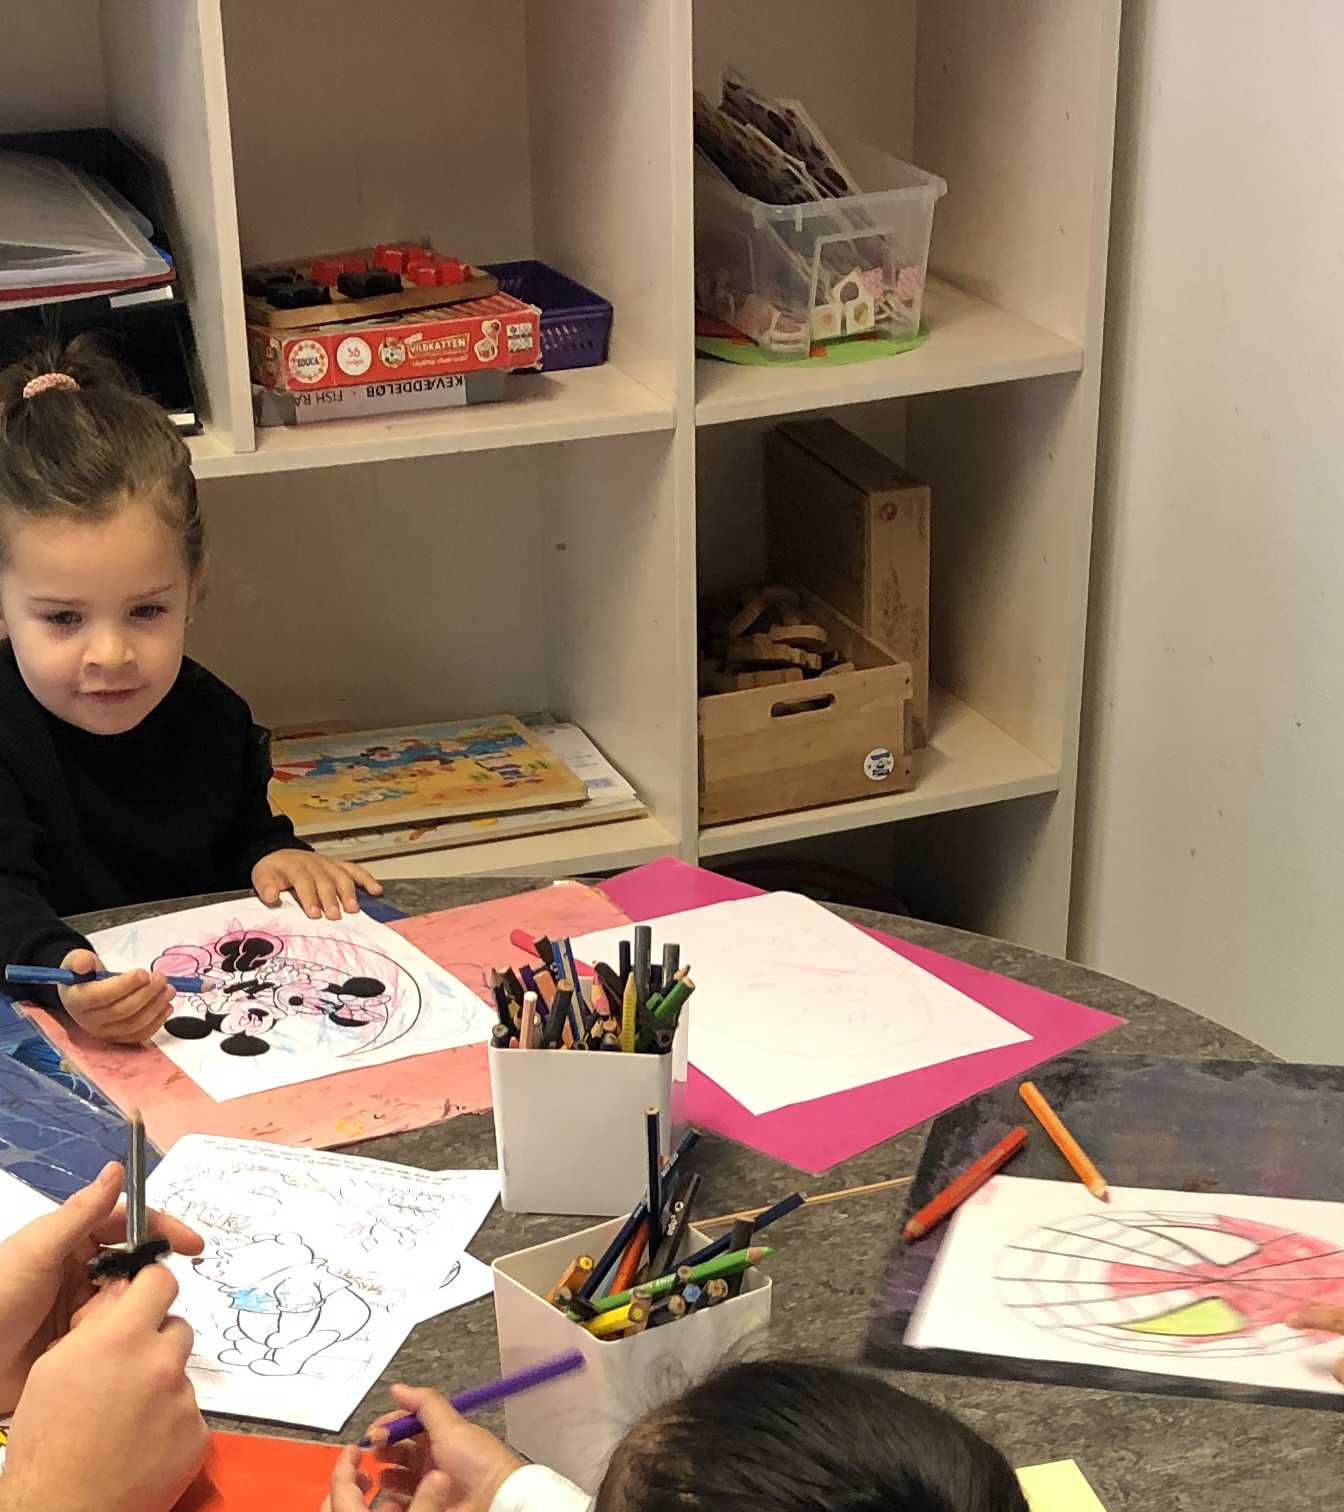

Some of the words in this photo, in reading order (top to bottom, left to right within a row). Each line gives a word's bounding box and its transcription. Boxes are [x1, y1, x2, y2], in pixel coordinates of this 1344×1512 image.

[410, 338, 466, 354] VILDKATTEN
[366, 376, 463, 398] KEVÆDDELØB
[316, 389, 343, 404] FISH
